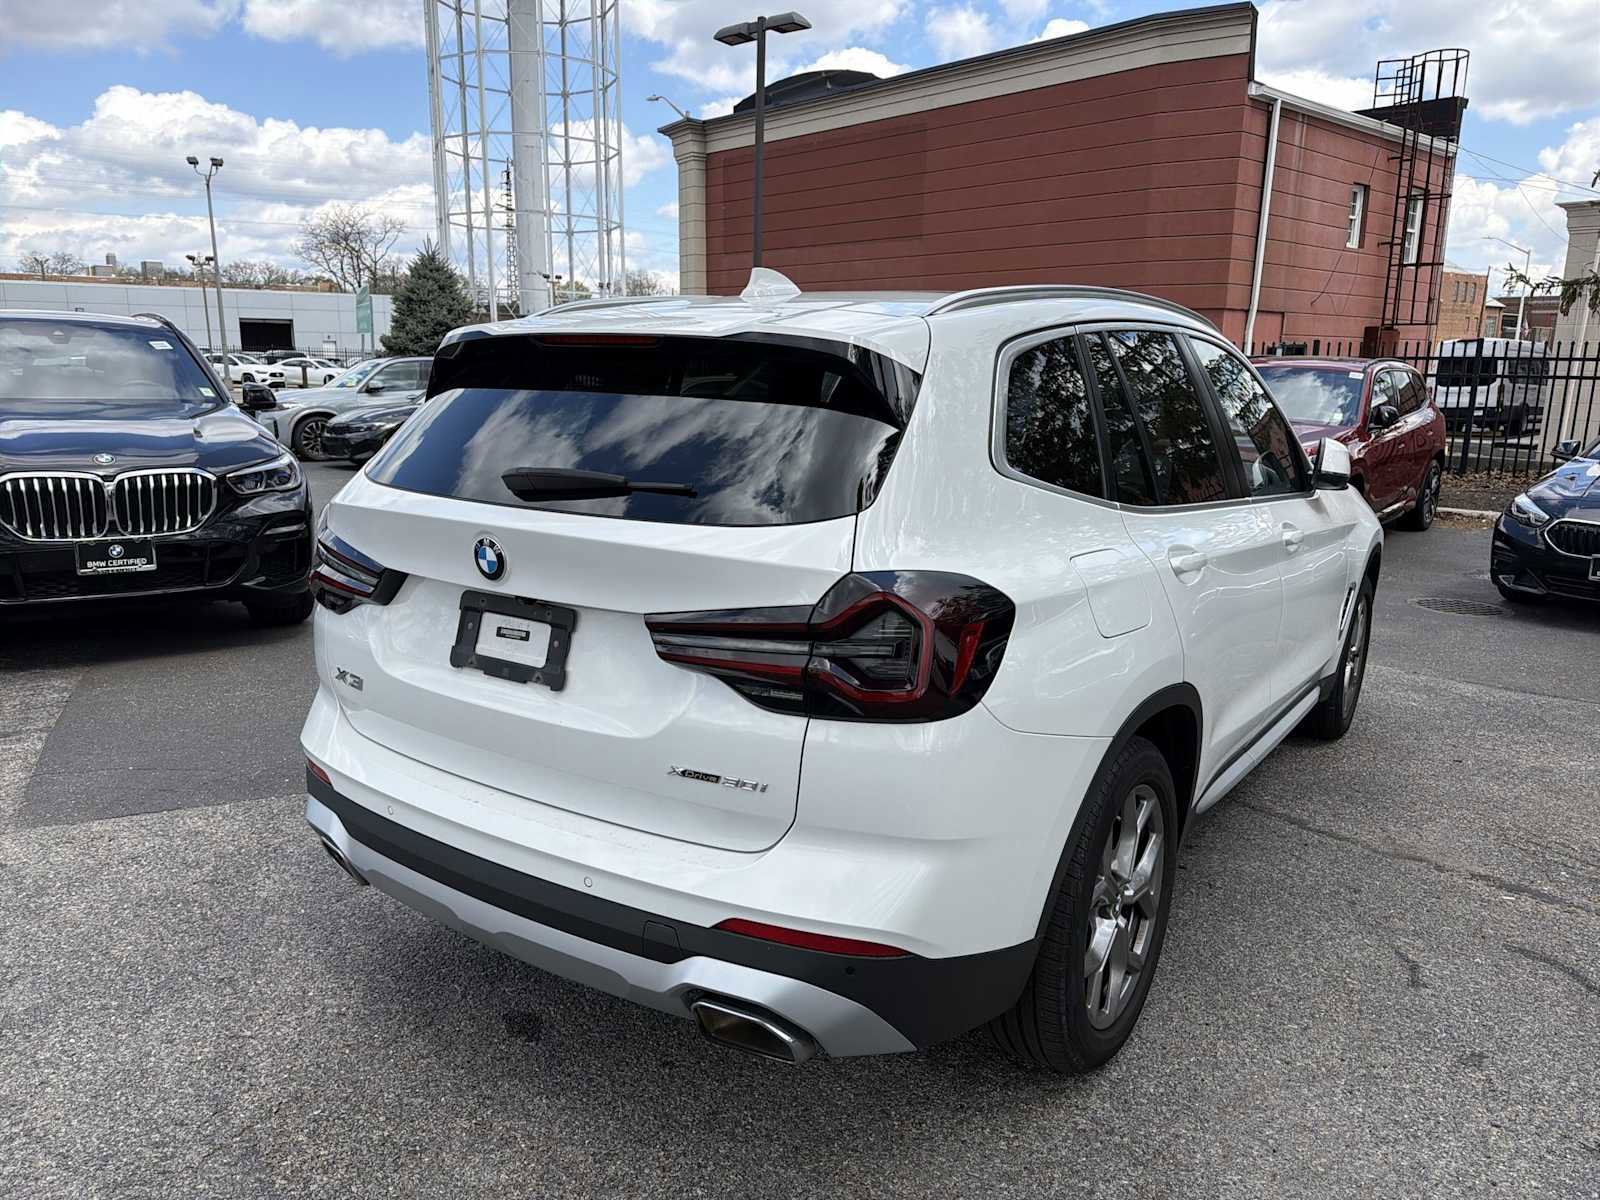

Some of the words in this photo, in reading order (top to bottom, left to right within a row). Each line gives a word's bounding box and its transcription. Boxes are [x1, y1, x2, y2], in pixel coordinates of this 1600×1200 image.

[87, 560, 107, 568] BMW
[108, 557, 148, 567] CERTIFIED
[335, 666, 363, 691] X3
